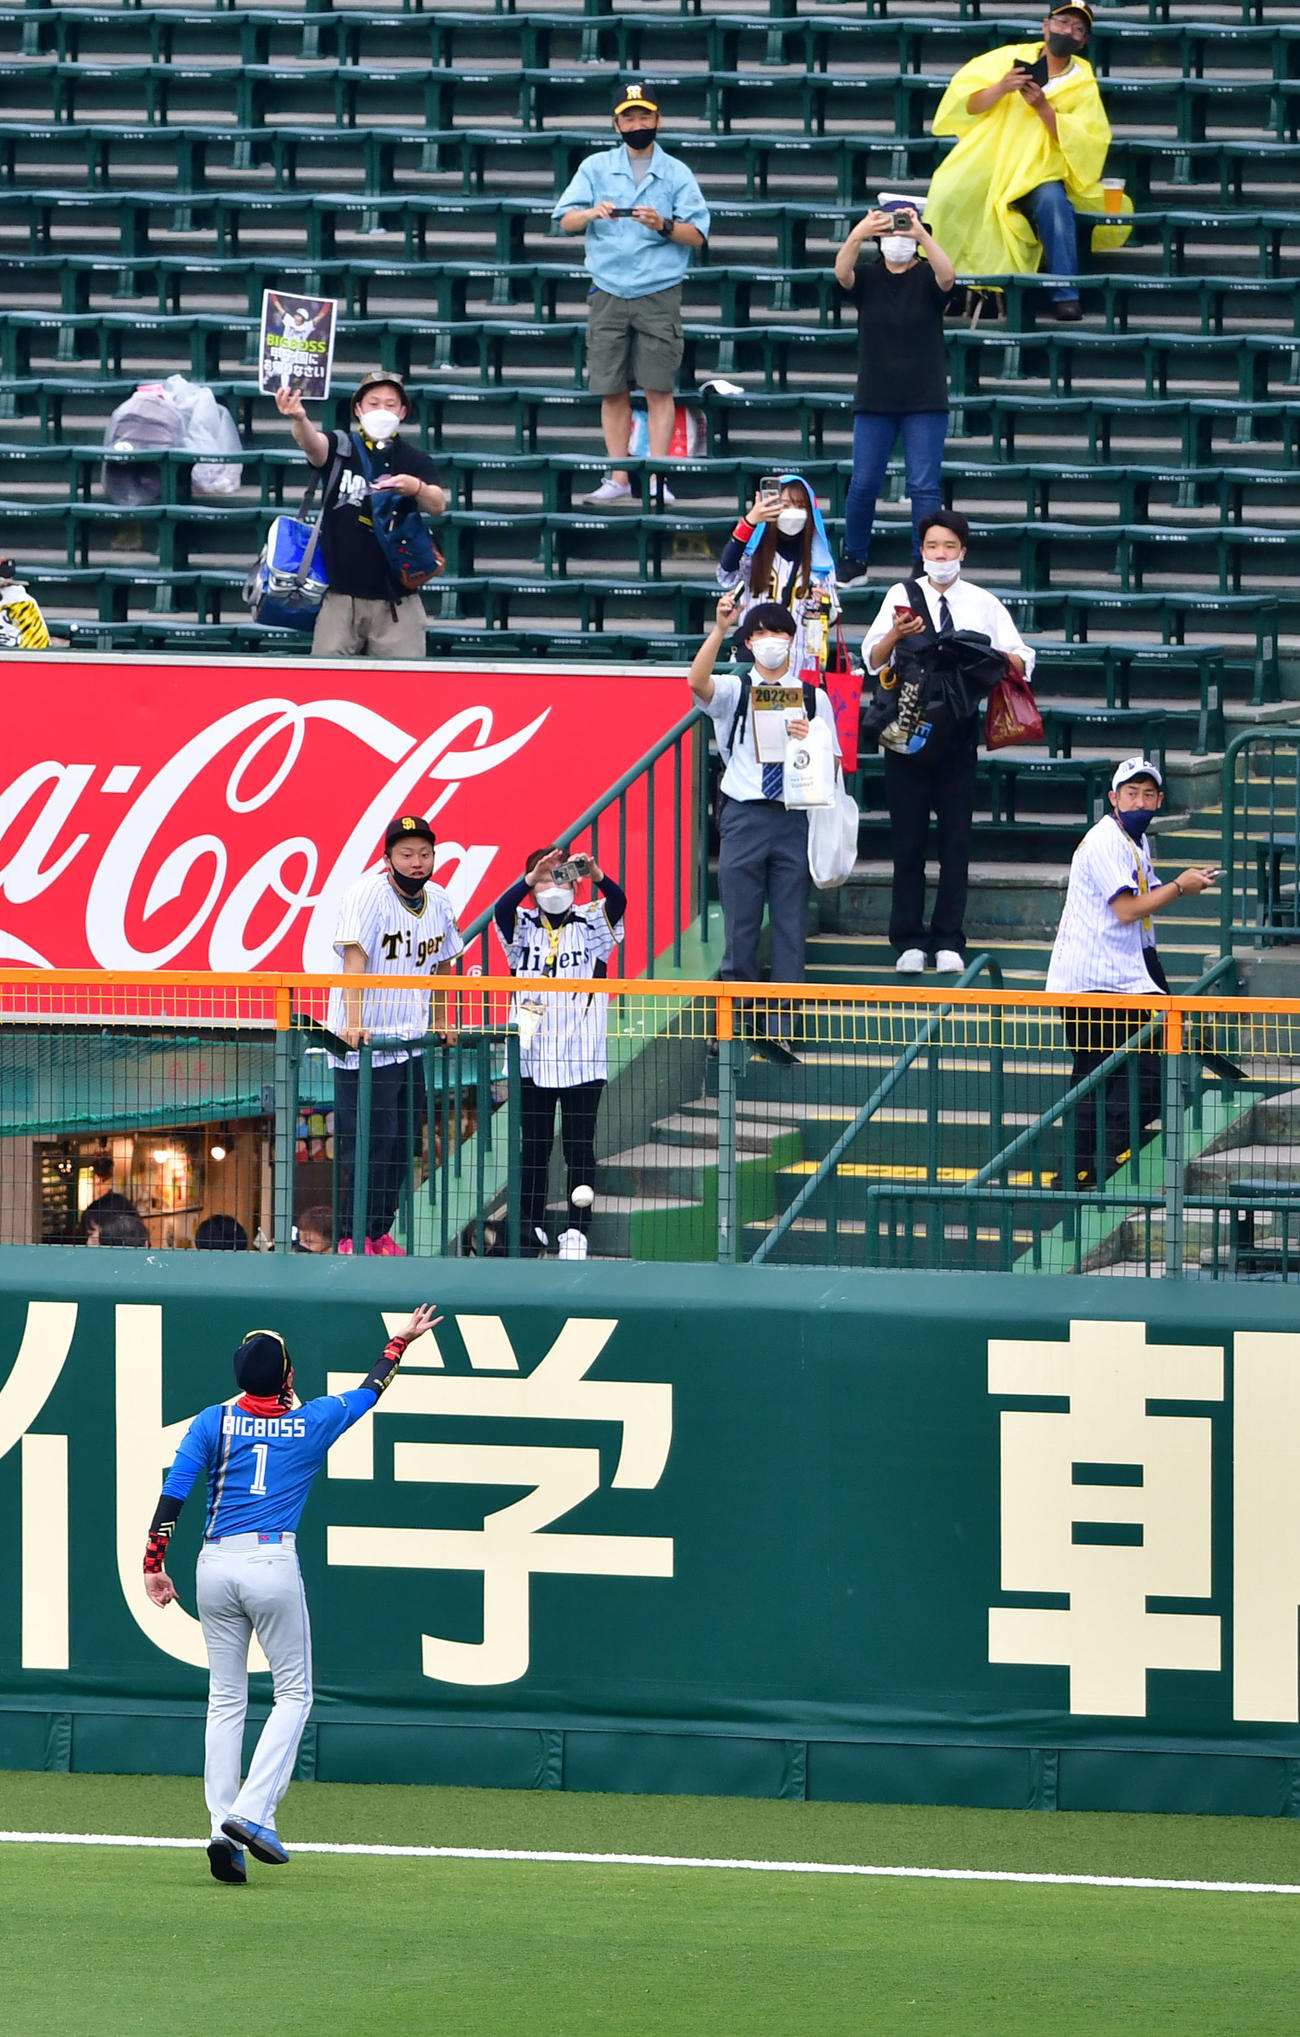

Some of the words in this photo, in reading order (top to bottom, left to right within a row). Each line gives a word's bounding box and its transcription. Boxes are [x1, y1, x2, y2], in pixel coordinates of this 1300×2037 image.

[266, 333, 327, 354] BIGBOSS
[381, 930, 447, 967] Tiger
[222, 1415, 306, 1438] BIGBOSS
[250, 1443, 269, 1496] 1
